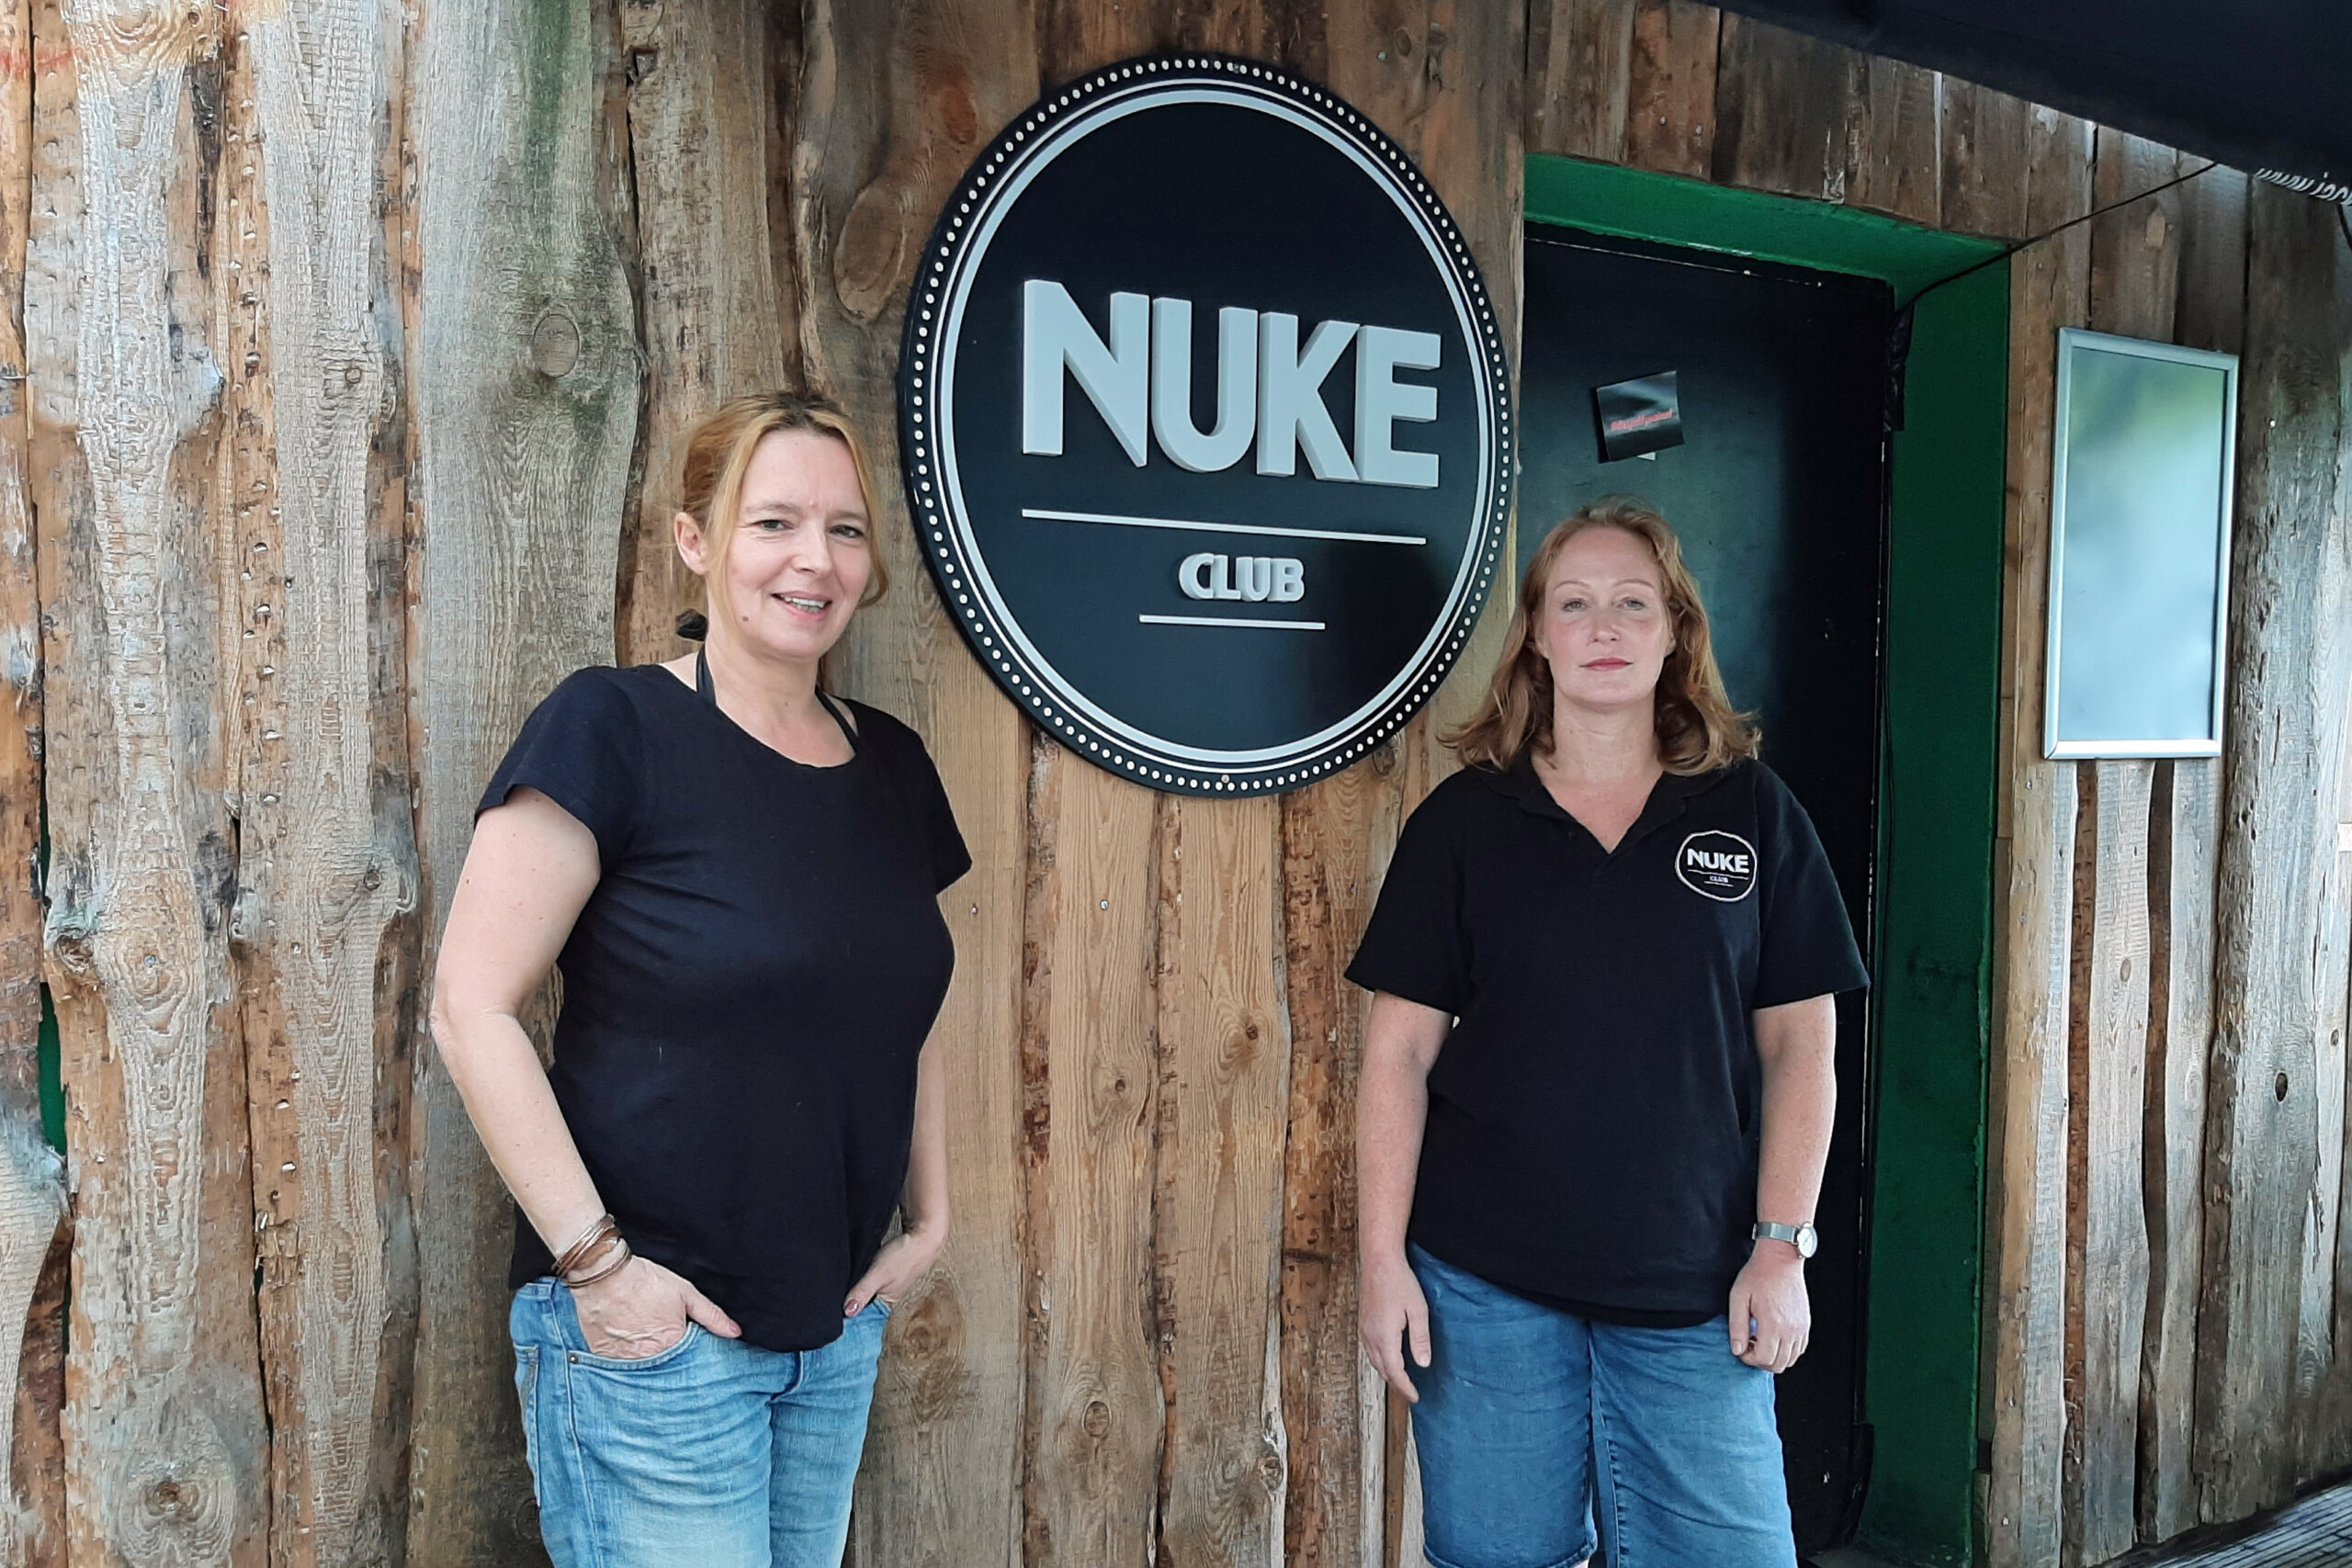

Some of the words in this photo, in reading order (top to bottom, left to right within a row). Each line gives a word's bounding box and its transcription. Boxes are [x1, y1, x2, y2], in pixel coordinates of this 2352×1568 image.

[1023, 278, 1442, 489] NUKE
[1179, 552, 1306, 603] CLUB
[1687, 848, 1749, 874] NUKE
